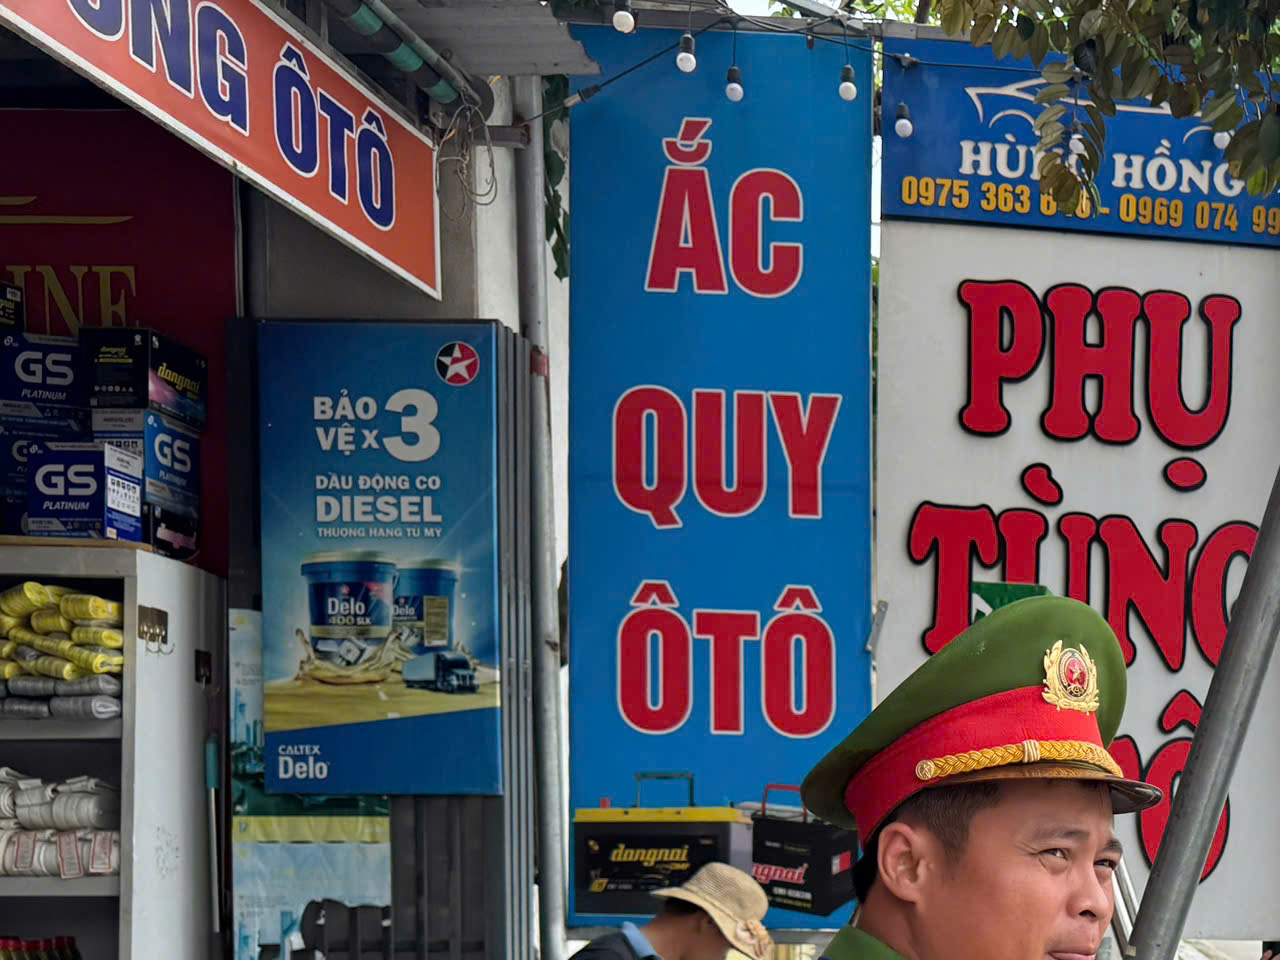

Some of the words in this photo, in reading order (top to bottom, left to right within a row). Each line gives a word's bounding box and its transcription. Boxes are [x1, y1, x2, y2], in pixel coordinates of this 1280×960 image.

[273, 40, 396, 231] ÔTÔ
[1112, 139, 1246, 197] HỒNG
[644, 117, 804, 298] ẮC
[902, 176, 970, 208] 0975
[980, 181, 1031, 214] 363
[1119, 194, 1183, 228] 0969
[1195, 202, 1238, 231] 074
[14, 351, 75, 386] GS
[958, 279, 1242, 491] PHỤ
[21, 388, 67, 401] PLATINUM
[313, 388, 378, 420] BẢO
[315, 422, 356, 456] VỆ
[382, 388, 441, 463] 3
[154, 432, 192, 474] GS
[611, 385, 843, 529] QUY
[35, 464, 98, 496] GS
[42, 501, 90, 511] PLATINUM
[316, 495, 443, 523] DIESEL
[327, 597, 366, 616] Delo
[617, 579, 837, 740] ÔTÔ
[278, 744, 321, 756] CALTEX
[278, 755, 329, 780] Delo
